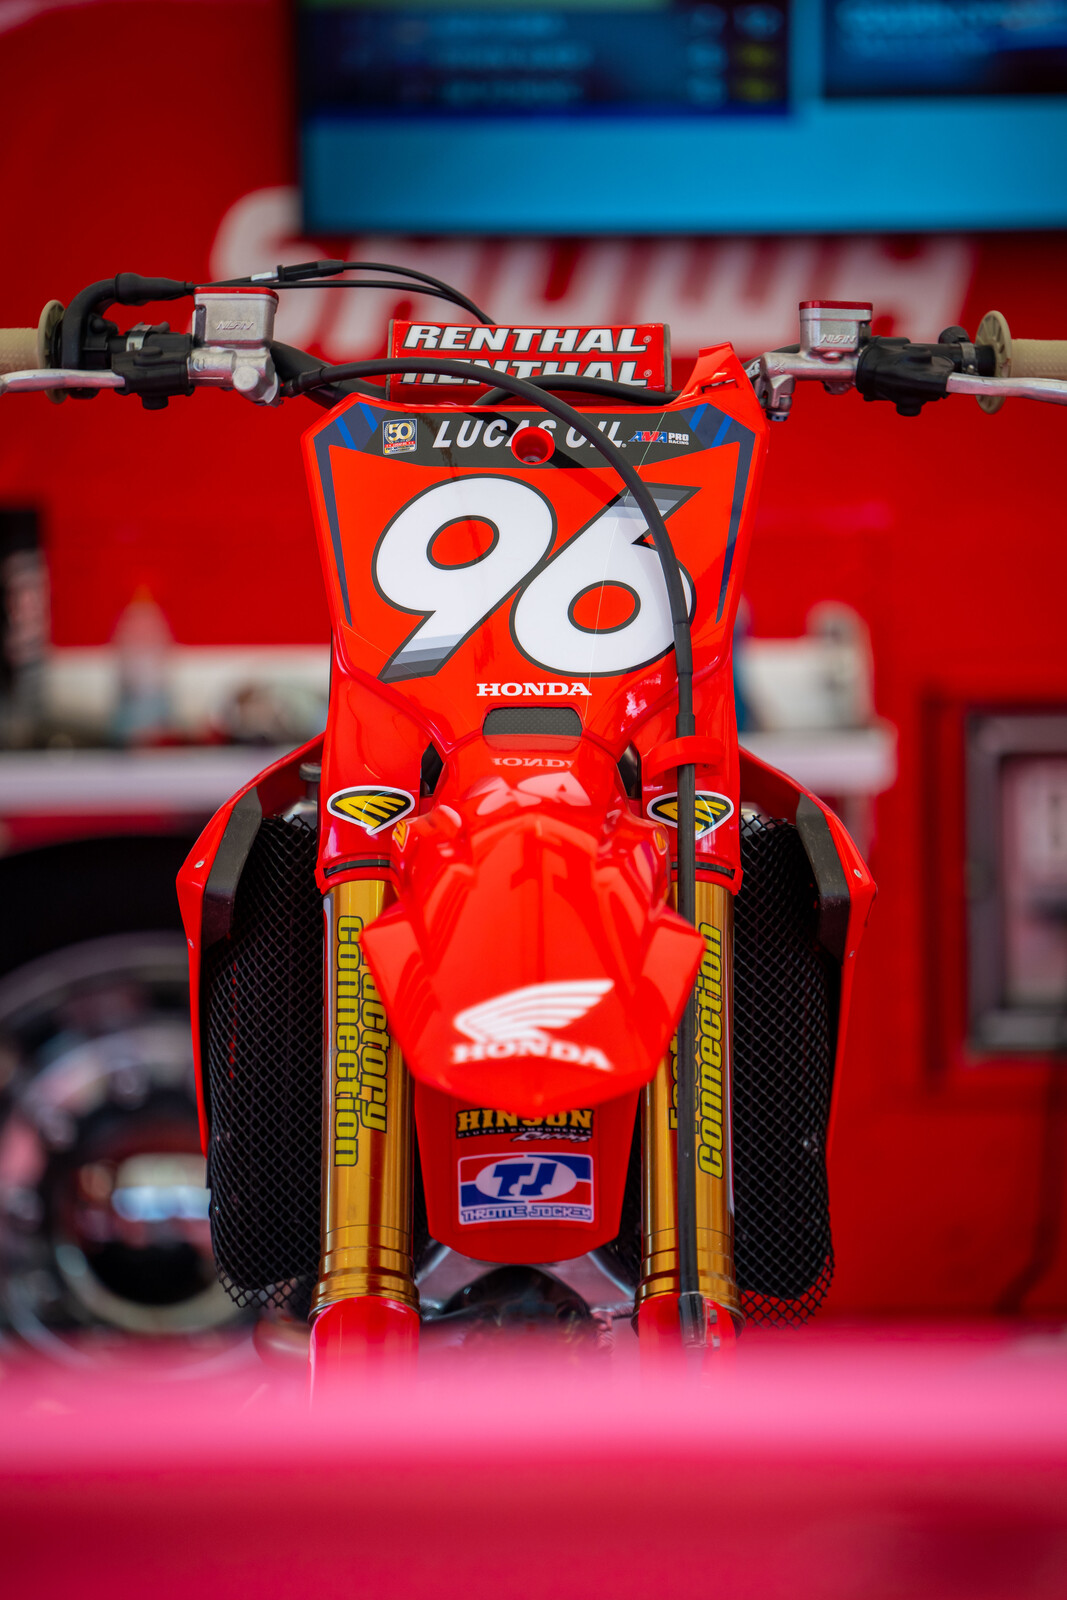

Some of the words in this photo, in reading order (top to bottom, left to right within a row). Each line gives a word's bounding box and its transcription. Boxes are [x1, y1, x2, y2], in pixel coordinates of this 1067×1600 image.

[402, 324, 648, 353] RENTHAL
[388, 422, 413, 441] 50
[628, 430, 667, 443] AMA
[668, 432, 689, 441] PRO
[371, 473, 702, 684] 96
[476, 682, 592, 696] HONDA
[361, 953, 390, 1133] actory
[452, 1036, 616, 1072] HONDA
[528, 1204, 592, 1220] JOCKEY
